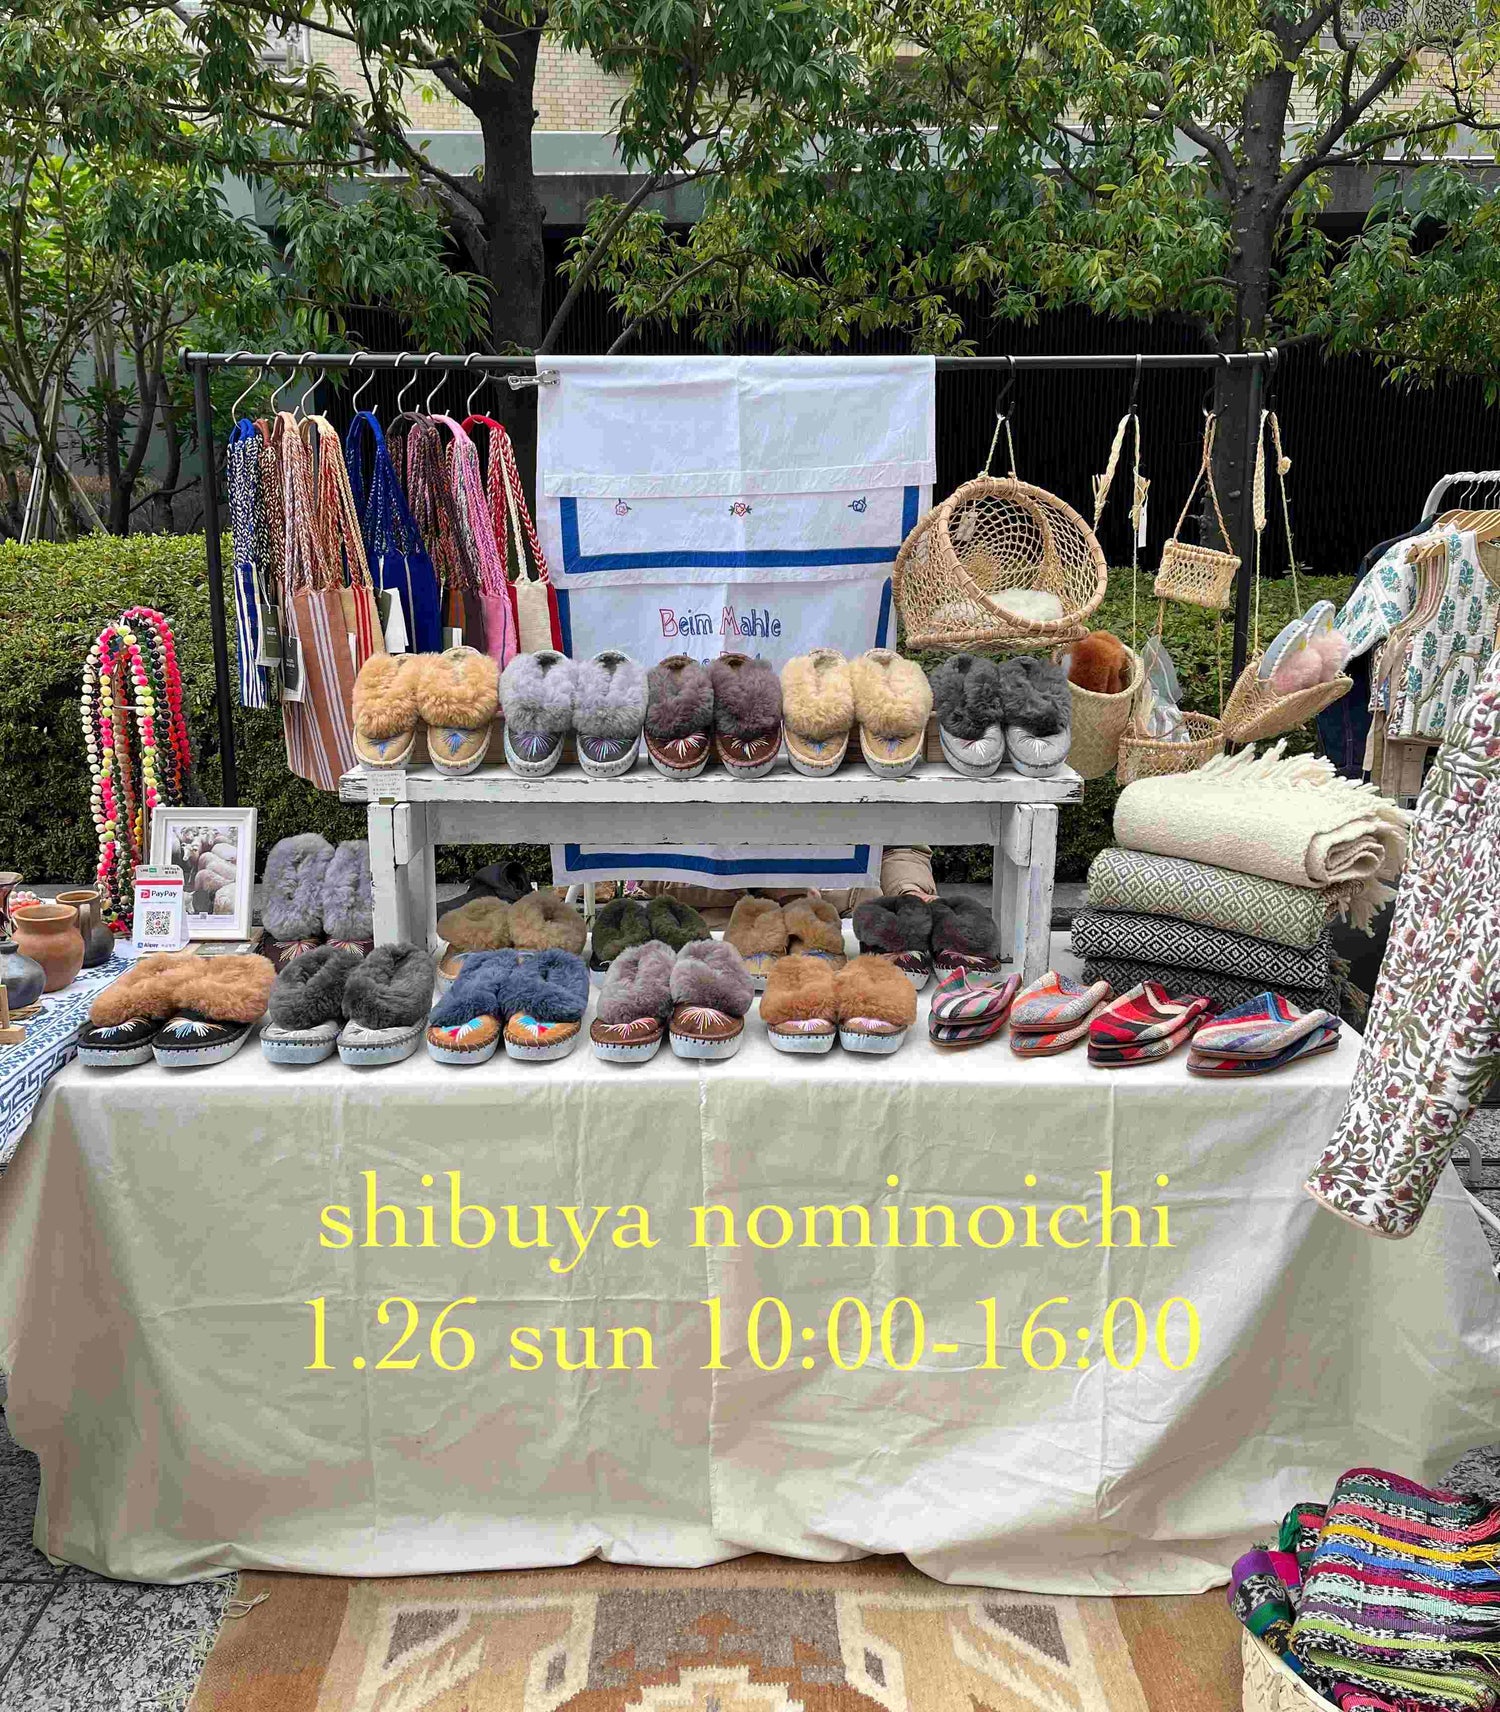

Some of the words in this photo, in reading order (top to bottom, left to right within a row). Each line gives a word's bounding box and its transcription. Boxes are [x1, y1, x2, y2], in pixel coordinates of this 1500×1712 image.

[659, 608, 713, 637] Beim
[719, 606, 782, 638] Mahle
[151, 890, 177, 898] PayPay
